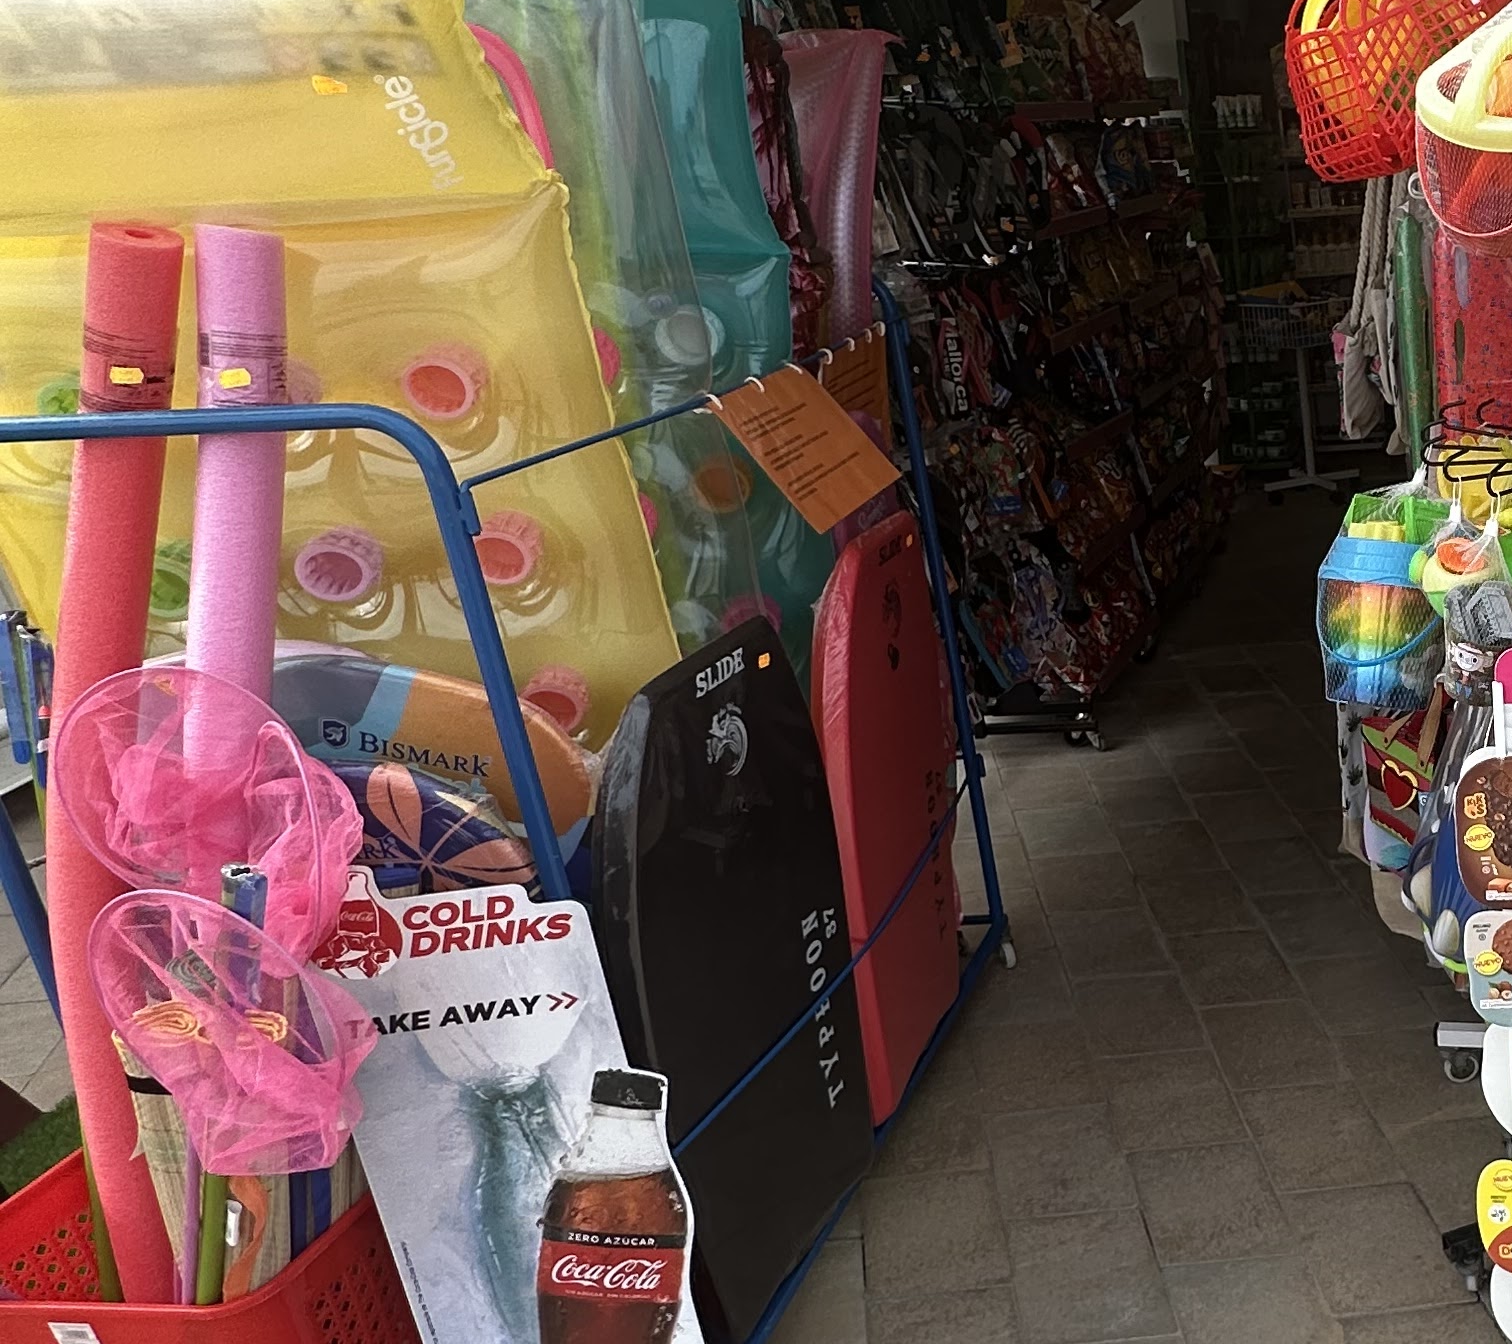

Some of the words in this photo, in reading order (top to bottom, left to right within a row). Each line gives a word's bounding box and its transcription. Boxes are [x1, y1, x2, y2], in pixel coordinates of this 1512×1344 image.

[695, 647, 745, 699] SLIDE
[402, 895, 515, 930] COLD
[409, 913, 574, 958] DRINKS
[344, 1009, 431, 1039] TAKE
[439, 994, 542, 1028] AWAY
[801, 910, 845, 1109] TYPHOON
[567, 1232, 600, 1245] ZERO
[551, 1254, 669, 1290] Coca-Cola
